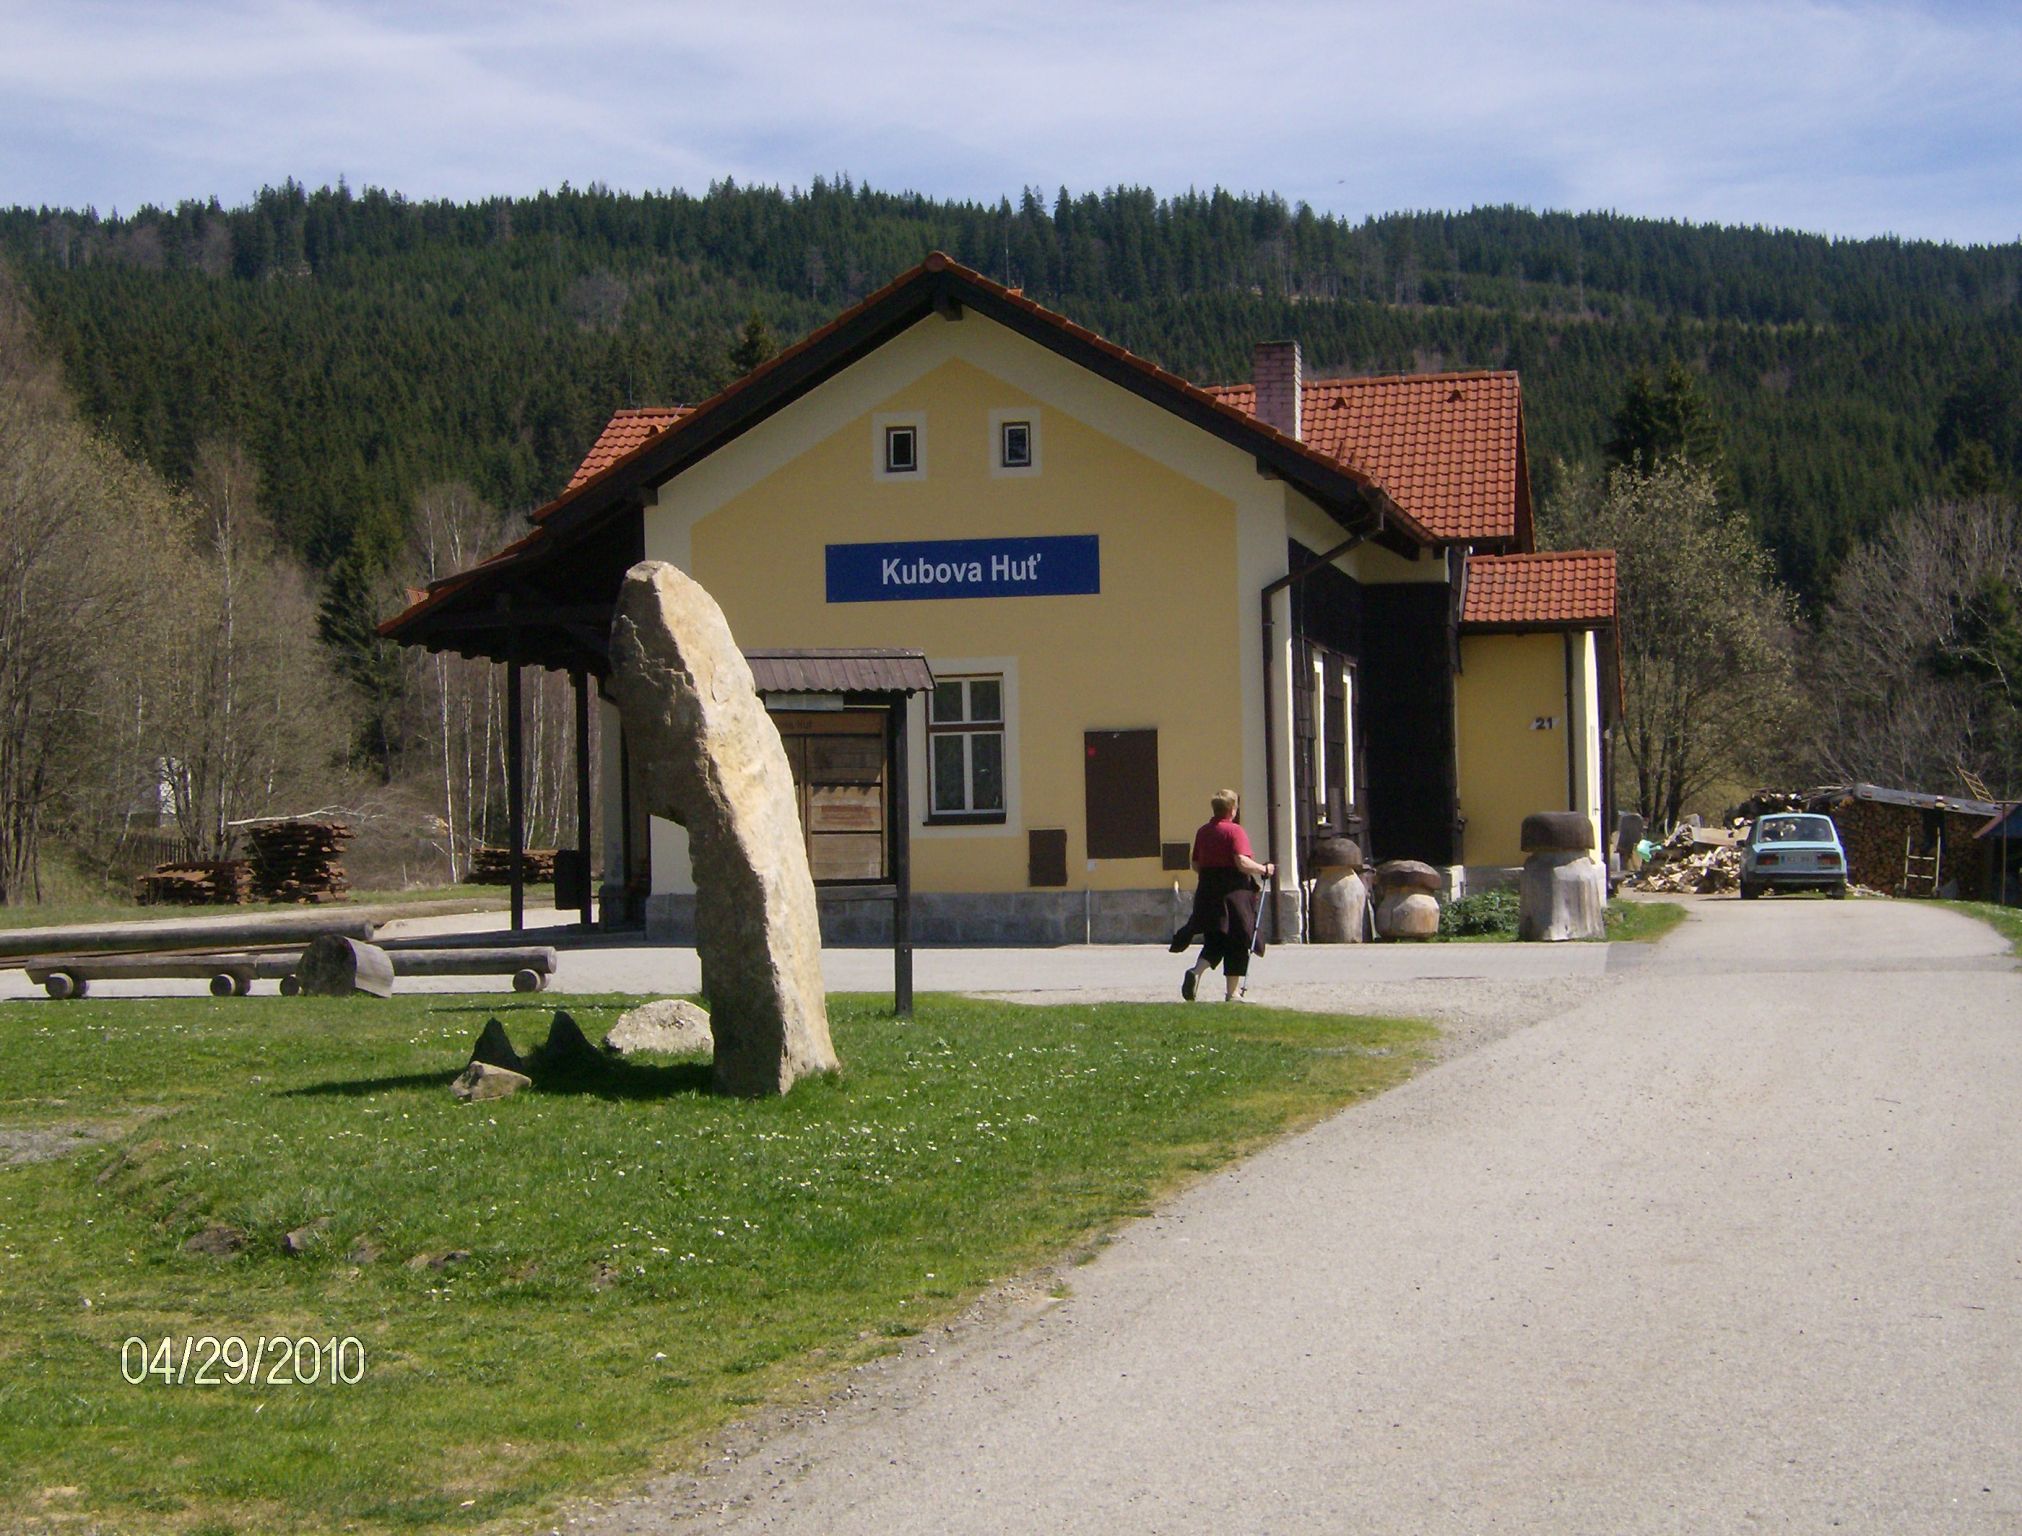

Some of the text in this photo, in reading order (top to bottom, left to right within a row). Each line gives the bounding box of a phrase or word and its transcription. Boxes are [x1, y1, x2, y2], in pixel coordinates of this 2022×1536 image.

[882, 553, 1041, 585] Kubova Huť
[1535, 716, 1553, 730] 21
